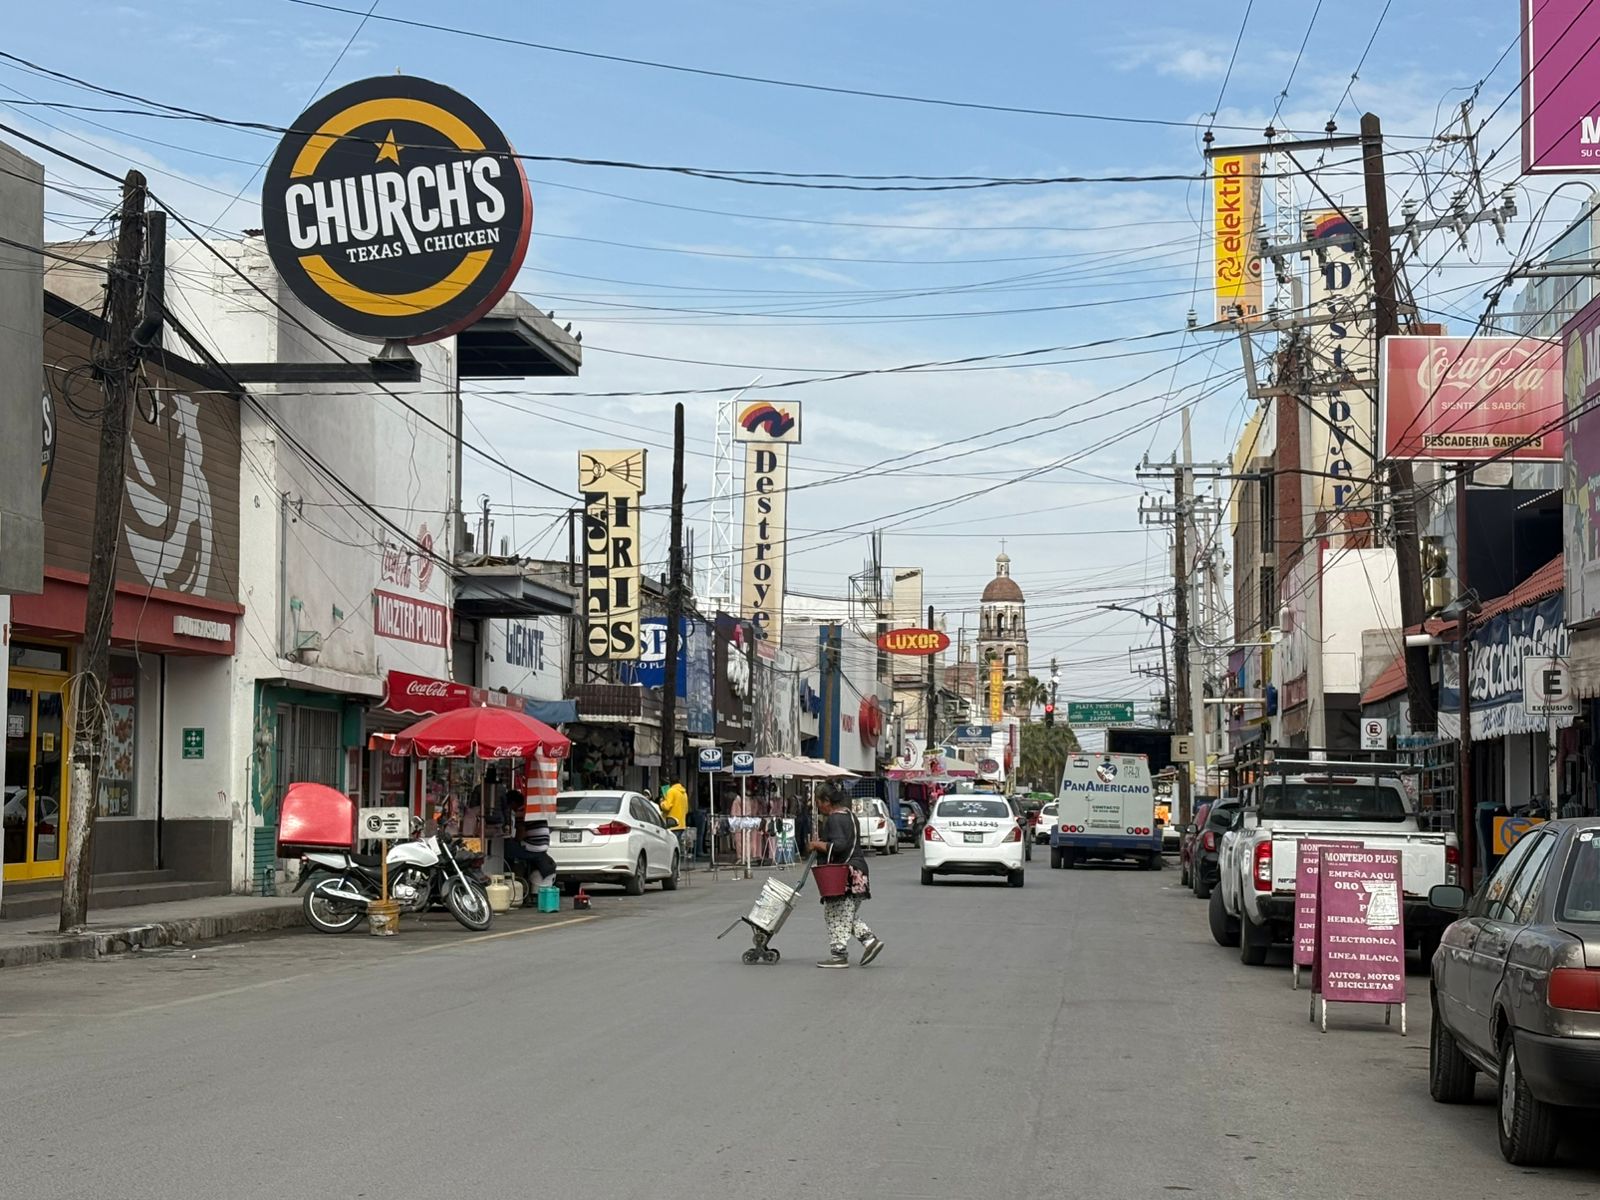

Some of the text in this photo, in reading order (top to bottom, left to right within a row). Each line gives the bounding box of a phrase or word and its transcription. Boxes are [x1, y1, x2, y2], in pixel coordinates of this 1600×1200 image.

[1581, 149, 1593, 157] SU
[285, 156, 506, 254] CHURCH'S
[1217, 160, 1241, 252] elektra
[346, 227, 500, 263] TEXAS CHICKEN
[1416, 346, 1544, 391] Coca-Cola
[1441, 401, 1526, 411] SIENTE EL SABOR
[1424, 435, 1489, 448] PESCADERIA
[587, 496, 609, 657] OPTICA
[611, 497, 636, 654] IRIS
[378, 594, 443, 646] MAZTER POLLO
[886, 633, 940, 650] LUXOR
[1542, 669, 1563, 696] E
[406, 680, 449, 698] Coca-Cola
[1179, 742, 1188, 754] E
[704, 750, 718, 760] SP
[737, 755, 751, 764] SP
[1325, 852, 1398, 864] MONTEPIO PLUS
[1328, 869, 1394, 881] EMPEÑA AQUI
[1334, 881, 1359, 890] ORO
[1357, 892, 1365, 901] Y
[1329, 935, 1397, 945] ELECTRONICA
[1328, 951, 1399, 963] LINEA BLANCA
[1328, 971, 1401, 981] AUTOS MOTOS
[1328, 980, 1394, 990] Y BICICLETAS
